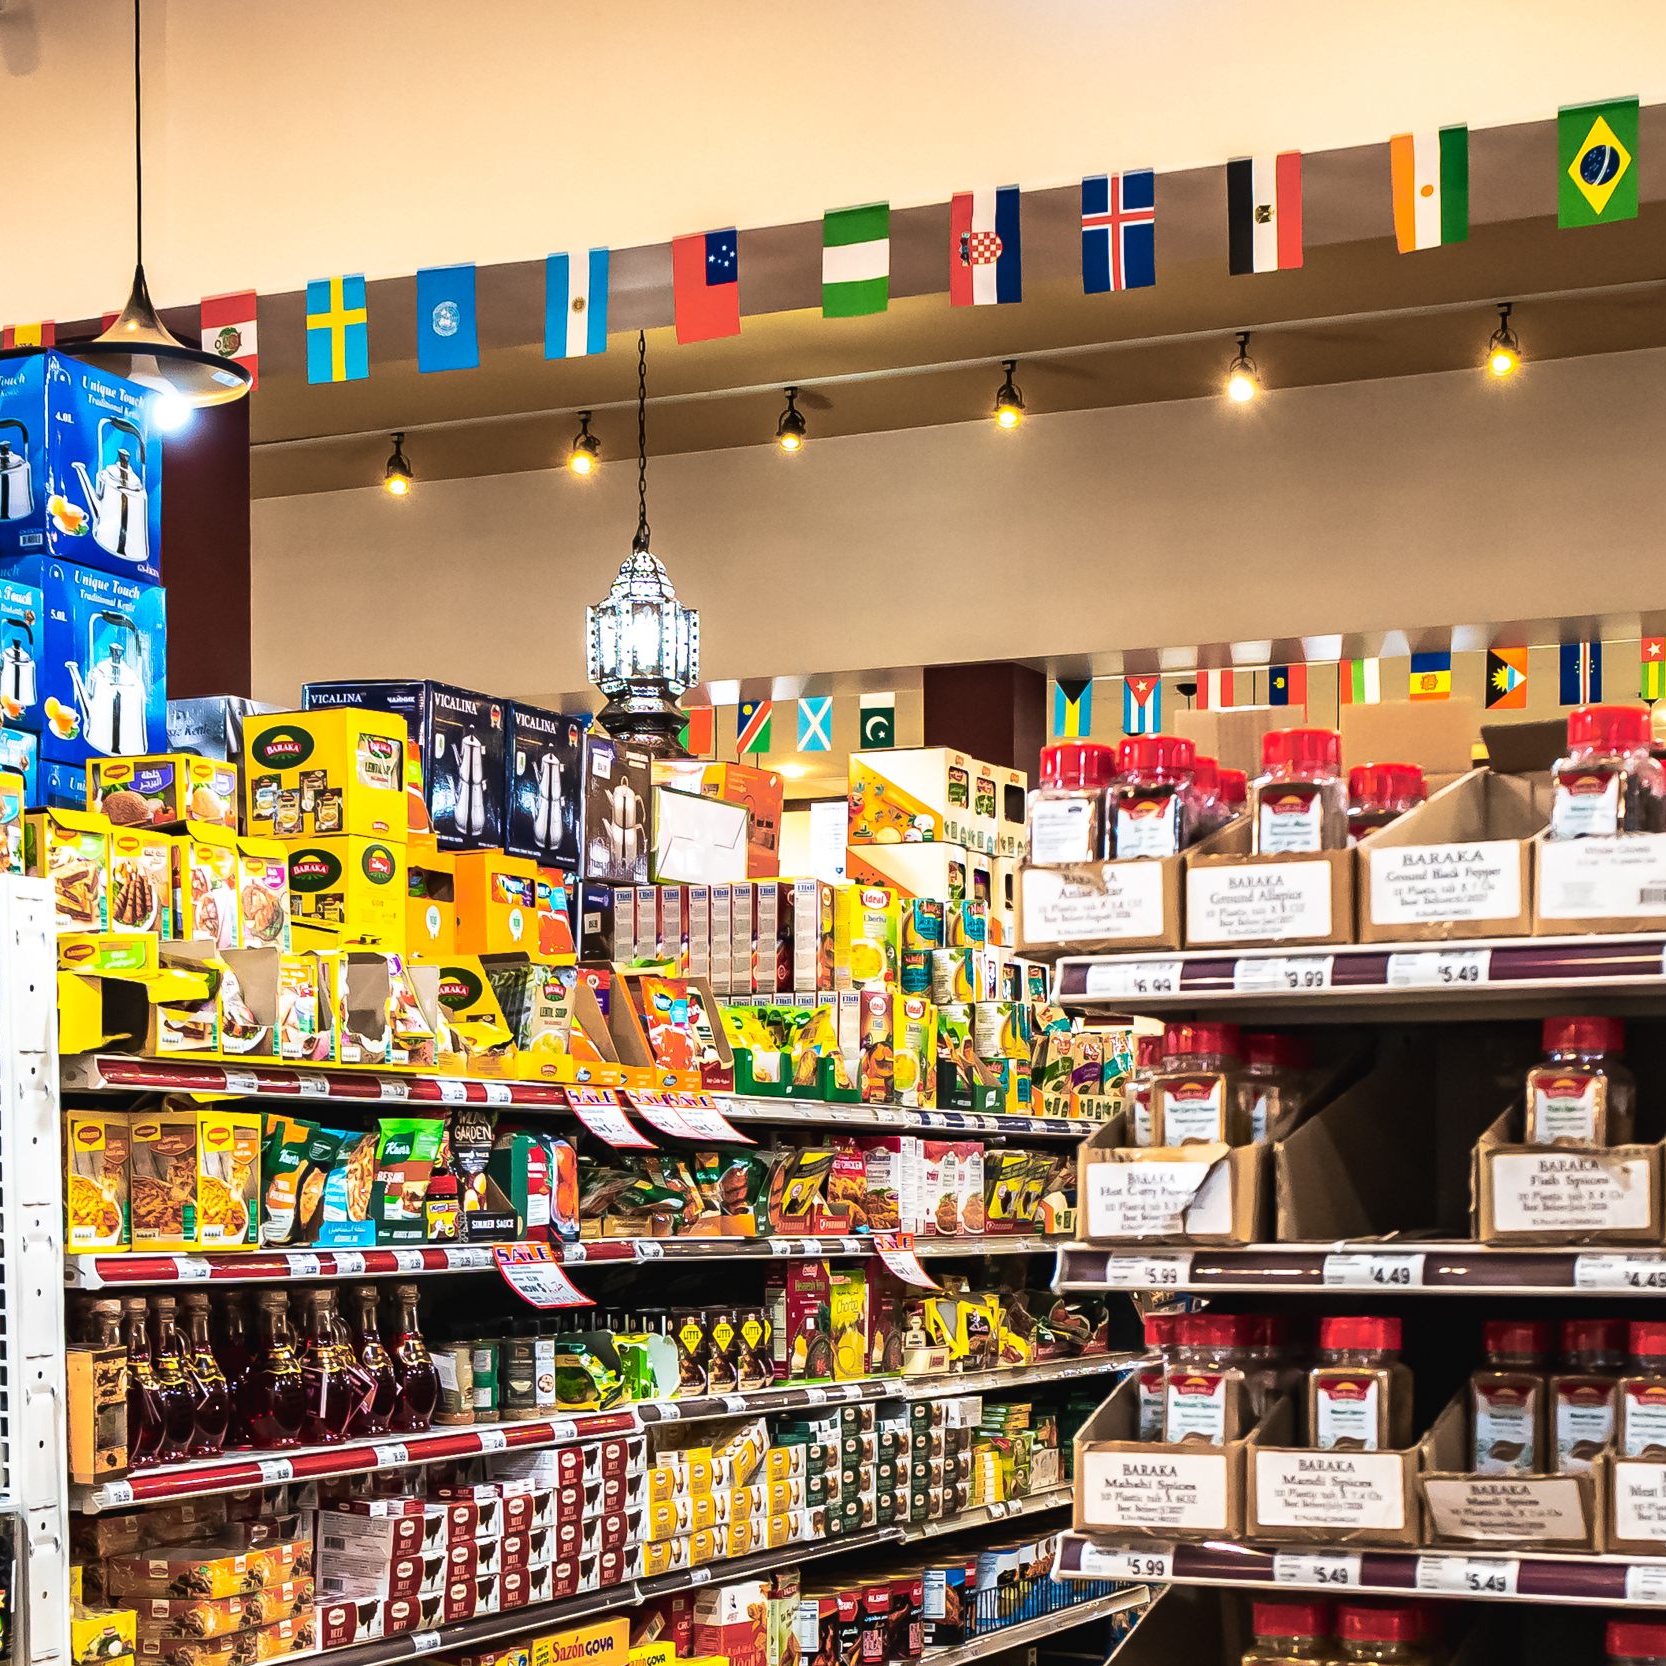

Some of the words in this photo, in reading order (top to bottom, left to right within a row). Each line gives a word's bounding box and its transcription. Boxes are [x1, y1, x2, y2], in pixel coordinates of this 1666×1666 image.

[81, 374, 117, 396] Unique
[119, 387, 146, 407] Touch
[74, 570, 108, 590] Unique
[111, 581, 140, 601] Touch
[3, 587, 33, 604] Touch
[311, 694, 362, 703] VICALINA
[434, 693, 478, 715] VICALINA
[515, 713, 557, 734] VICALINA
[265, 743, 300, 755] BARAKA
[1401, 849, 1484, 866] BARAKA
[293, 862, 330, 876] BARAKA
[863, 894, 885, 905] Ideal
[539, 1007, 554, 1018] LENTIL
[556, 1006, 568, 1018] SOUP
[906, 1005, 924, 1014] Ideal
[566, 1088, 615, 1105] SALE
[669, 1091, 712, 1107] SALE
[455, 1125, 493, 1141] GARDEN
[279, 1148, 300, 1165] Knorr
[386, 1142, 411, 1156] Knorr
[495, 1244, 551, 1262] SALE
[551, 1639, 584, 1663] Sazón
[585, 1637, 614, 1656] GOYA
[646, 1653, 666, 1666] GOYA
